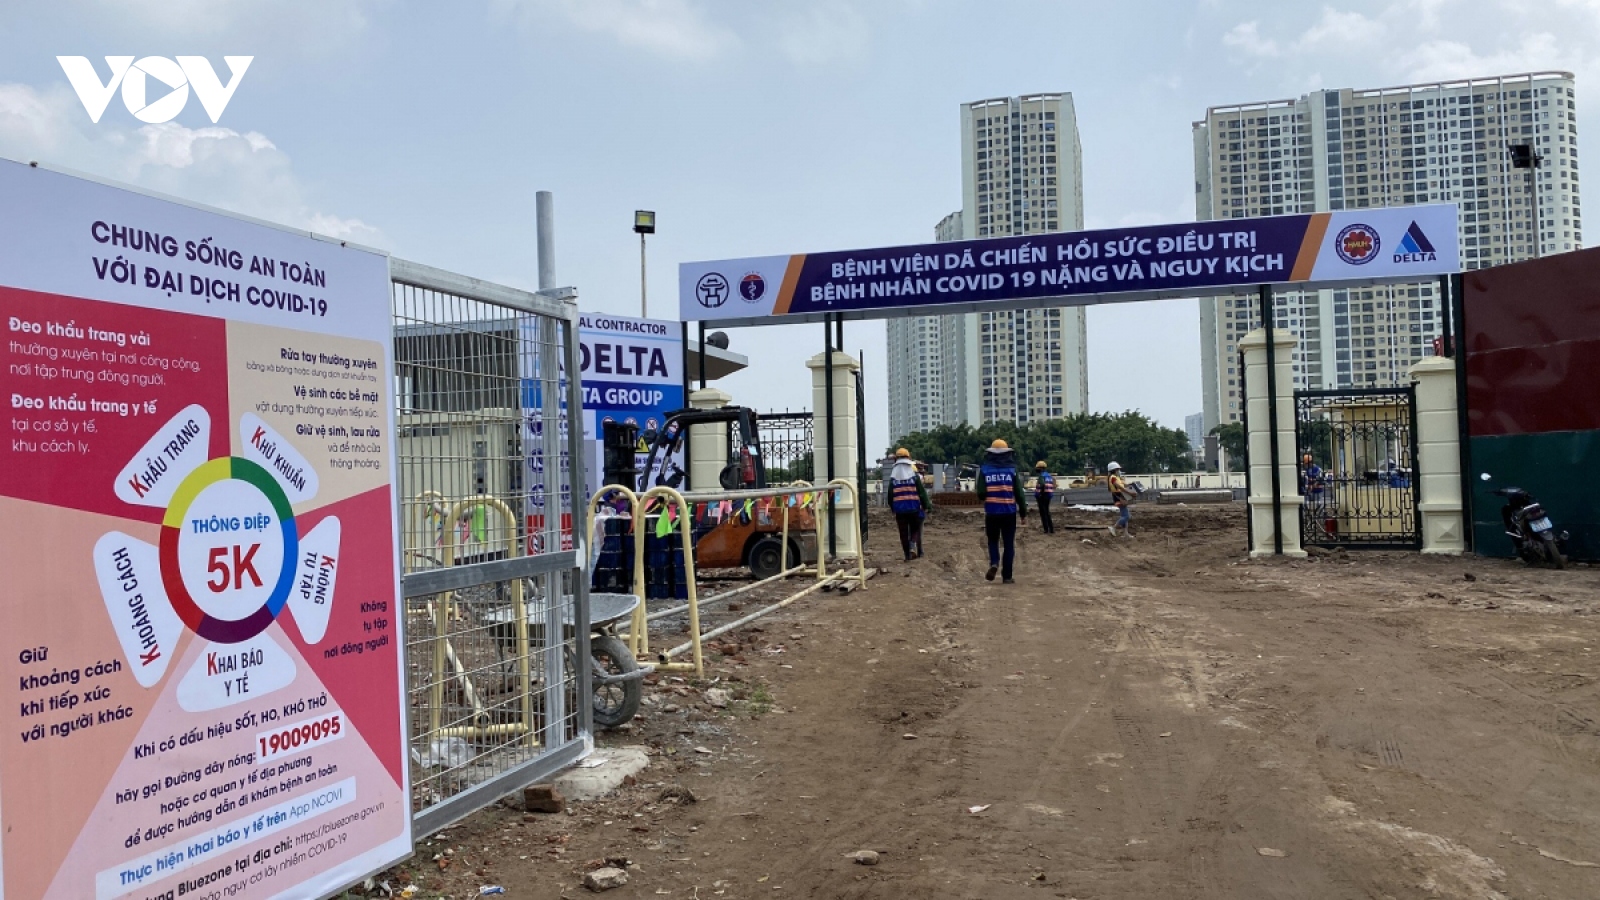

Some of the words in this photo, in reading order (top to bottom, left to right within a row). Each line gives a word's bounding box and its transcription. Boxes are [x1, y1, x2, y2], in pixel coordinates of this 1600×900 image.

[91, 220, 179, 257] CHUNG
[185, 236, 244, 270] SỐNG
[249, 255, 275, 278] AN
[280, 262, 326, 288] TOÀN
[831, 258, 886, 282] BỆNH
[890, 252, 940, 277] VIỆN
[944, 248, 976, 270] DÃ
[980, 241, 1048, 267] CHIẾN
[1057, 237, 1099, 261] HỒI
[1104, 235, 1152, 258] SỨC
[1156, 230, 1214, 254] ĐIỀU
[1218, 231, 1257, 253] TRỊ
[1393, 252, 1437, 263] DELTA
[92, 255, 136, 285] VỚI
[144, 266, 183, 297] ĐẠI
[190, 275, 241, 304] DỊCH
[246, 286, 328, 317] COVID-19
[811, 282, 865, 305] BỆNH
[870, 276, 932, 298] NHÂN
[935, 273, 1005, 293] COVID
[1010, 271, 1036, 288] 19
[1041, 264, 1109, 289] NẶNG
[1112, 260, 1145, 282] VÀ
[1150, 257, 1210, 278] NGUY
[1225, 253, 1284, 277] KỊCH
[9, 316, 42, 334] Đeo
[46, 319, 84, 339] khẩu
[88, 326, 126, 347] trang
[130, 330, 151, 346] vải
[595, 318, 667, 335] CONTRACTOR
[9, 340, 58, 360] thường
[61, 347, 98, 362] xuyên
[101, 350, 117, 365] tại
[119, 352, 137, 365] nơi
[140, 354, 169, 370] công
[281, 347, 300, 361] Rửa
[302, 350, 317, 365] tay
[319, 352, 350, 369] thường
[352, 358, 377, 371] xuyên
[10, 363, 32, 376] nơi
[34, 363, 58, 379] tập
[61, 366, 94, 383] trung
[97, 369, 129, 386] đông
[11, 393, 45, 409] Đeo
[48, 393, 87, 412] khẩu
[90, 398, 129, 416] trang
[132, 403, 140, 416] y
[143, 399, 158, 414] tế
[293, 384, 307, 400] Vệ
[308, 387, 328, 399] sinh
[330, 387, 347, 400] các
[362, 391, 379, 405] mặt
[604, 387, 664, 406] GROUP
[12, 417, 29, 433] tại
[32, 420, 52, 432] cơ
[54, 418, 69, 432] sở
[71, 423, 80, 434] y
[296, 423, 313, 436] Giữ
[315, 424, 326, 439] vệ
[328, 425, 349, 439] sinh,
[350, 426, 364, 437] lau
[12, 439, 37, 453] khu
[40, 439, 75, 453] cách
[78, 439, 91, 455] ly.
[128, 458, 168, 499] KHẨU
[163, 419, 201, 461] TRANG
[251, 425, 276, 460] KHỬ
[273, 454, 306, 492] KHUẨN
[985, 474, 1012, 483] DELTA
[192, 515, 241, 534] THÔNG
[244, 512, 271, 532] ĐIỆP
[112, 547, 139, 592] CÁCH
[207, 543, 263, 593] 5K
[304, 552, 317, 569] TỤ
[300, 574, 314, 600] TẬP
[314, 555, 335, 605] KHÔNG
[360, 600, 387, 613] Không
[131, 592, 161, 667] KHOẢNG
[363, 621, 372, 633] tụ
[374, 616, 387, 631] tập
[19, 646, 48, 664] Giữ
[207, 651, 237, 676] KHAI
[241, 647, 264, 669] BÁO
[341, 642, 363, 655] đông
[20, 668, 80, 691] khoảng
[84, 659, 122, 678] cách
[224, 681, 233, 697] Y
[236, 672, 250, 694] TẾ
[20, 699, 45, 717] khi
[49, 689, 79, 710] tiếp
[84, 685, 111, 703] xúc
[21, 724, 45, 743] với
[50, 713, 93, 737] người
[98, 705, 133, 725] khác
[134, 741, 155, 759] Khi
[159, 735, 176, 752] có
[179, 727, 204, 746] dấu
[207, 722, 232, 739] hiệu
[235, 710, 258, 730] SỐT,
[261, 709, 280, 723] HO,
[283, 698, 305, 717] KHÓ
[308, 691, 327, 710] THỞ
[116, 788, 138, 805] hãy
[143, 779, 161, 799] gọi
[165, 769, 201, 789] Đường
[204, 761, 224, 776] dây
[228, 752, 256, 768] nóng:
[259, 715, 341, 757] 19009095
[160, 796, 189, 814] hoặc
[193, 790, 207, 803] cơ
[210, 781, 237, 799] quan
[239, 777, 246, 789] y
[247, 768, 258, 785] tế
[260, 767, 276, 781] địa
[278, 756, 312, 776] phương
[125, 828, 141, 848] để
[144, 823, 174, 841] được
[177, 809, 212, 829] hướng
[215, 798, 236, 815] dẫn
[239, 796, 249, 807] đi
[251, 785, 278, 803] khám
[279, 776, 303, 793] bệnh
[305, 771, 317, 783] an
[318, 764, 338, 779] toàn
[120, 864, 152, 886] Thực
[156, 851, 184, 871] hiện
[187, 838, 214, 859] khai
[217, 829, 240, 847] báo
[243, 825, 250, 839] y
[253, 814, 265, 832] tế
[266, 811, 287, 828] trên
[289, 802, 310, 819] App
[312, 788, 342, 810] NCOVI
[178, 865, 232, 896] Bluezone
[235, 854, 250, 873] tại
[253, 847, 271, 865] địa
[274, 836, 293, 855] chỉ:
[224, 877, 248, 897] nguy
[308, 832, 347, 858] COVID-19
